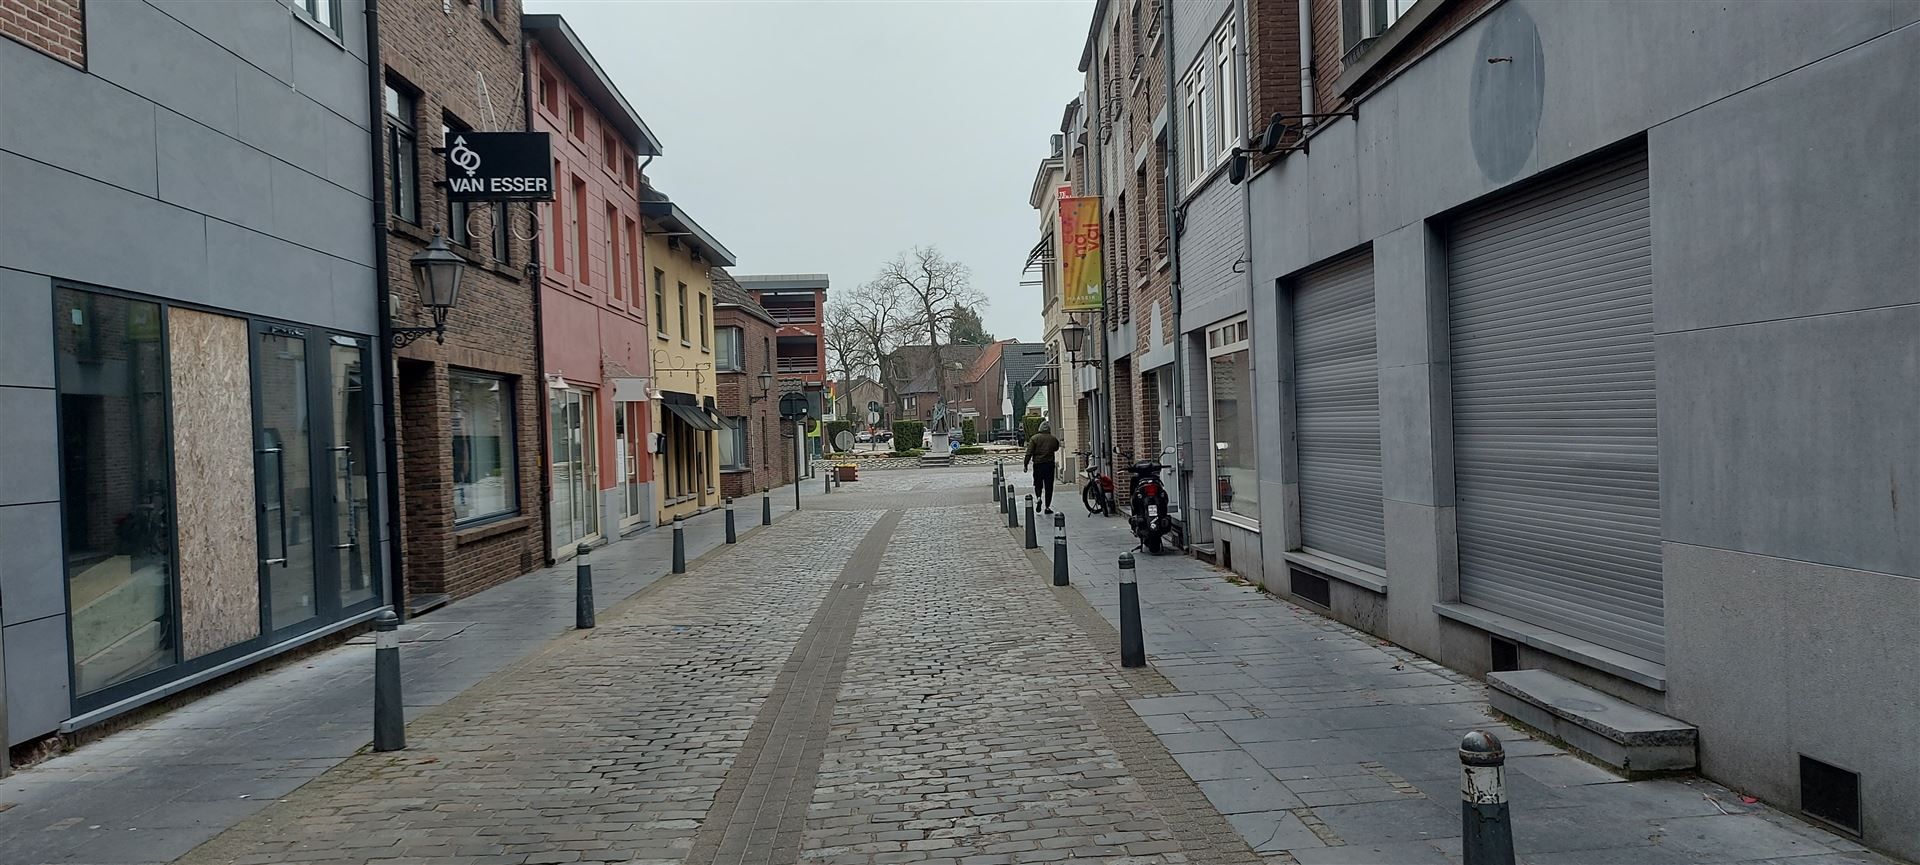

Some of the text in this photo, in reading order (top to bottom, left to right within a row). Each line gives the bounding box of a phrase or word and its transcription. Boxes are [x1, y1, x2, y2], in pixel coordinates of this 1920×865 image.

[449, 177, 548, 192] VAN ESSER
[1082, 223, 1099, 251] val
